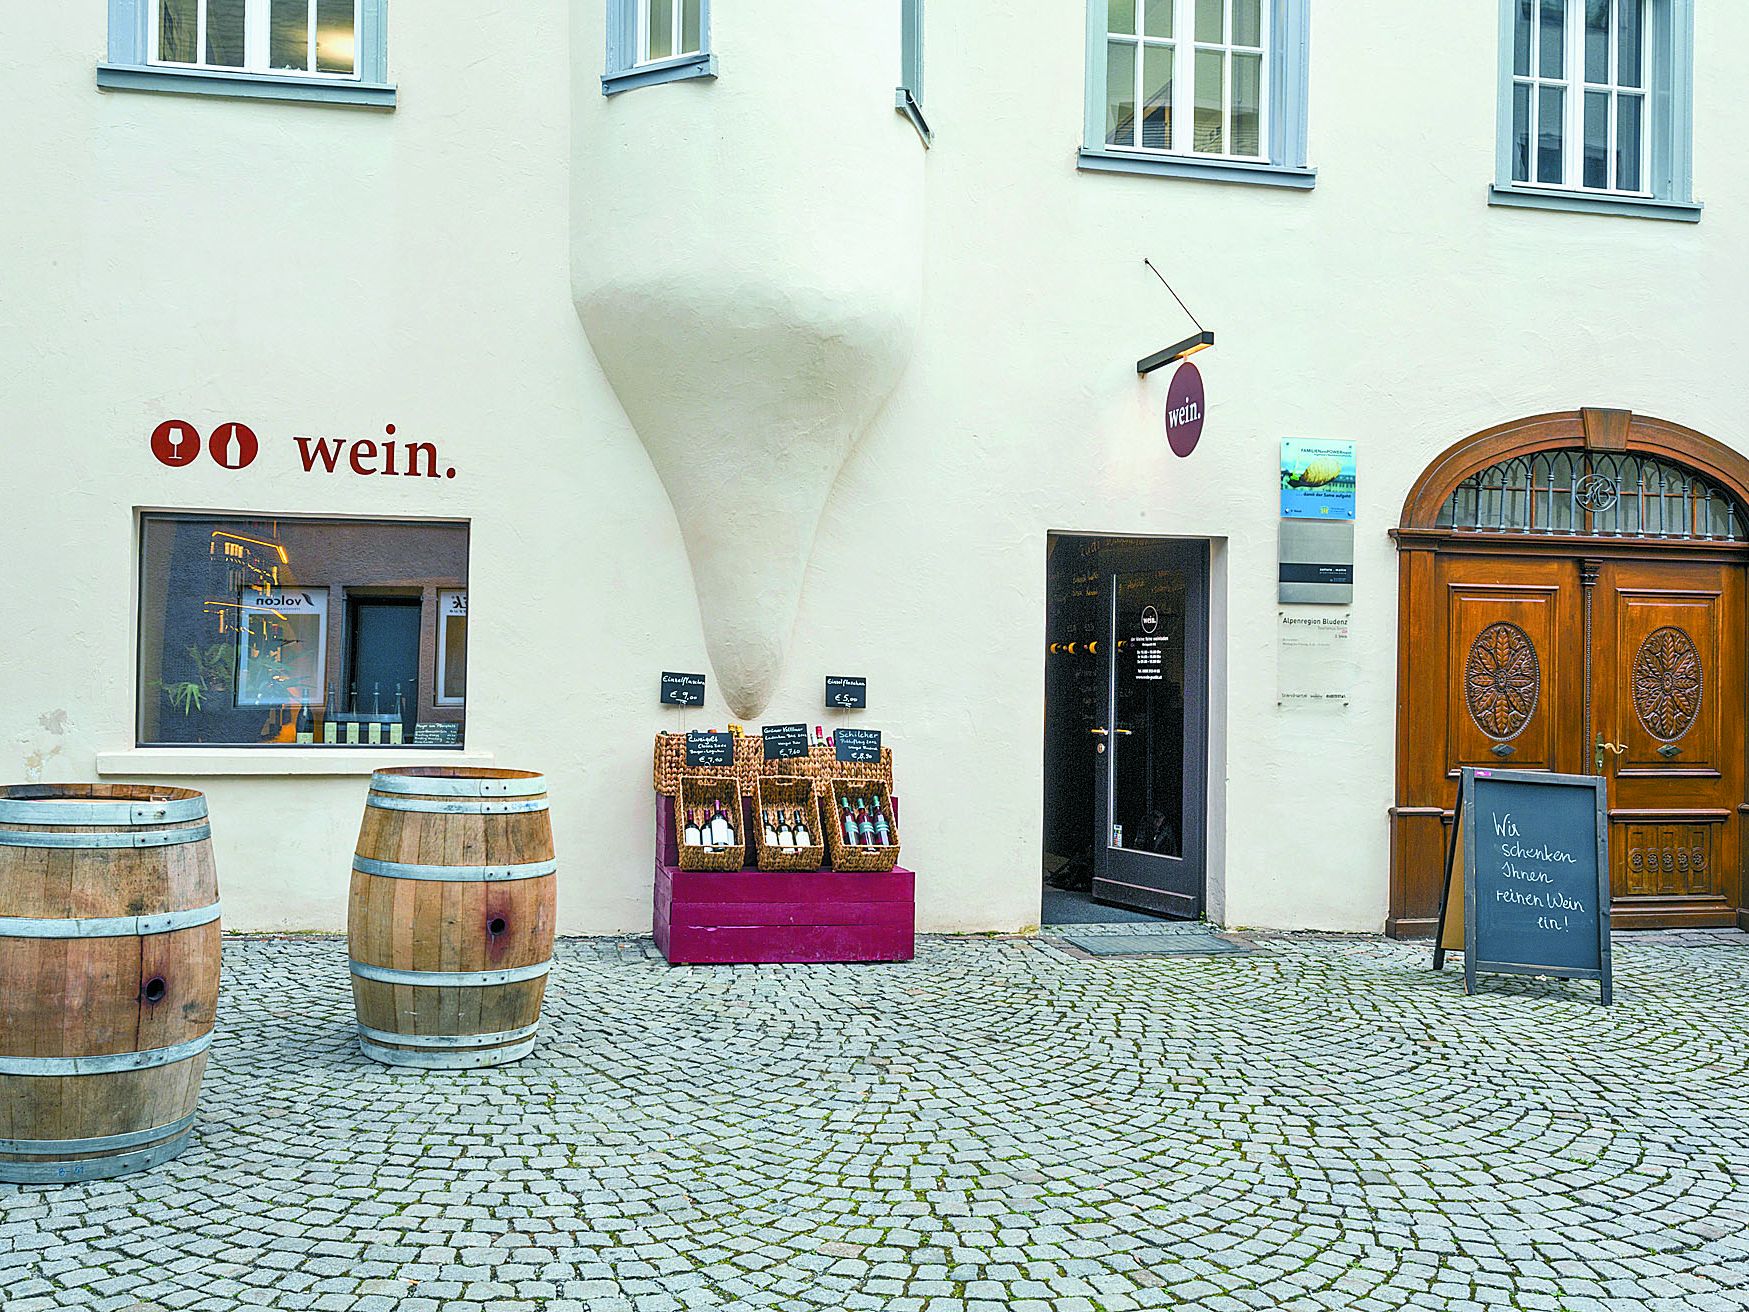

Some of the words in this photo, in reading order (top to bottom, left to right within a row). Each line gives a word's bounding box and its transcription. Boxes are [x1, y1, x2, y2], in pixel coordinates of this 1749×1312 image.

[1168, 396, 1202, 429] wein.
[293, 423, 457, 479] wein.
[1283, 617, 1321, 626] Alpenregion
[838, 730, 879, 739] Schilcher
[1492, 811, 1521, 837] Wir
[1501, 841, 1577, 864] schenken
[1501, 861, 1554, 884] Ihnen
[1496, 889, 1544, 908] reinen
[1545, 892, 1585, 912] Wein
